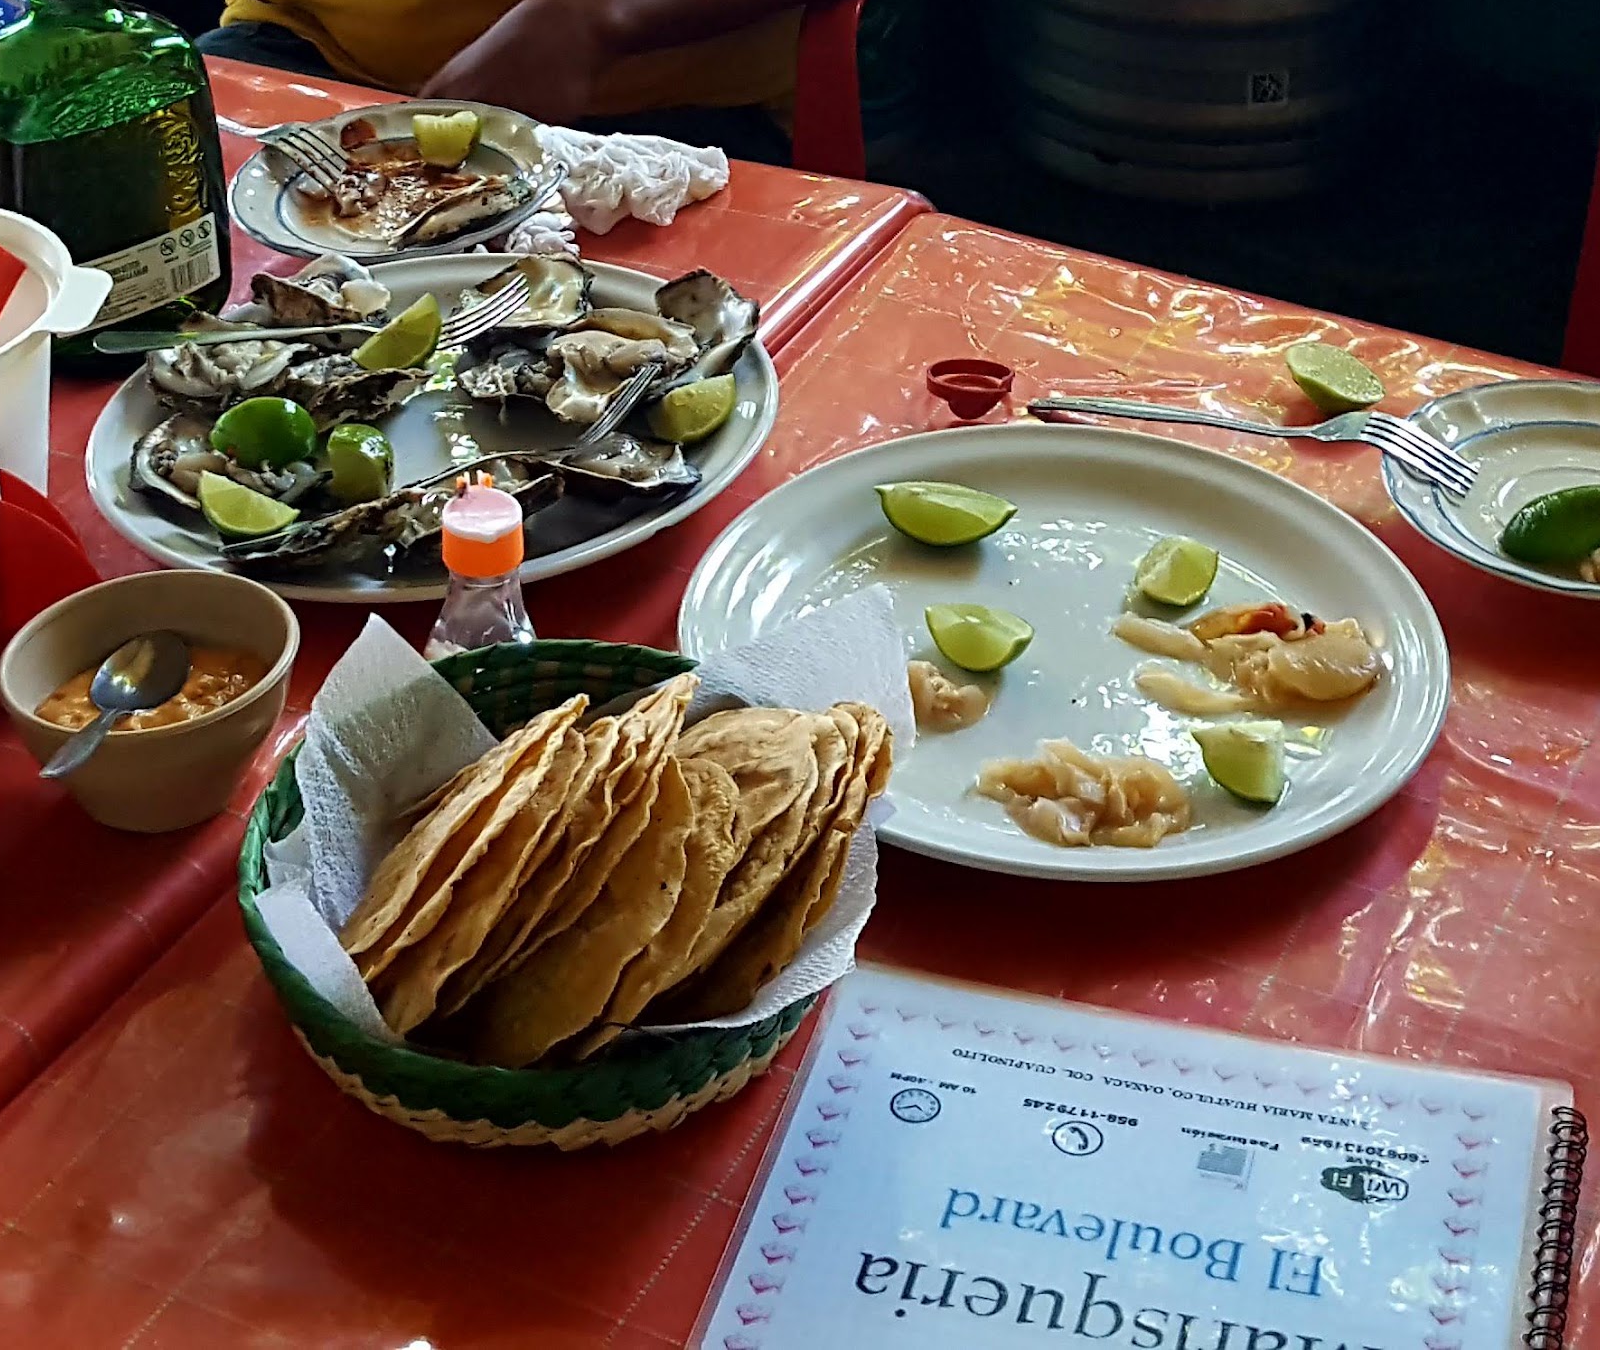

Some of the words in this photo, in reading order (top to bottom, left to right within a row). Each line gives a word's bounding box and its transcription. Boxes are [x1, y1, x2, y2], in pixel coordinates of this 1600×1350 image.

[951, 1047, 1057, 1077] CUAPINOLITO
[1022, 1098, 1139, 1127] 958-1179245
[1180, 1126, 1280, 1152] Facturación
[939, 1187, 1247, 1283] Boulevard
[1267, 1247, 1324, 1297] El
[854, 1250, 1384, 1350] arisqueria
